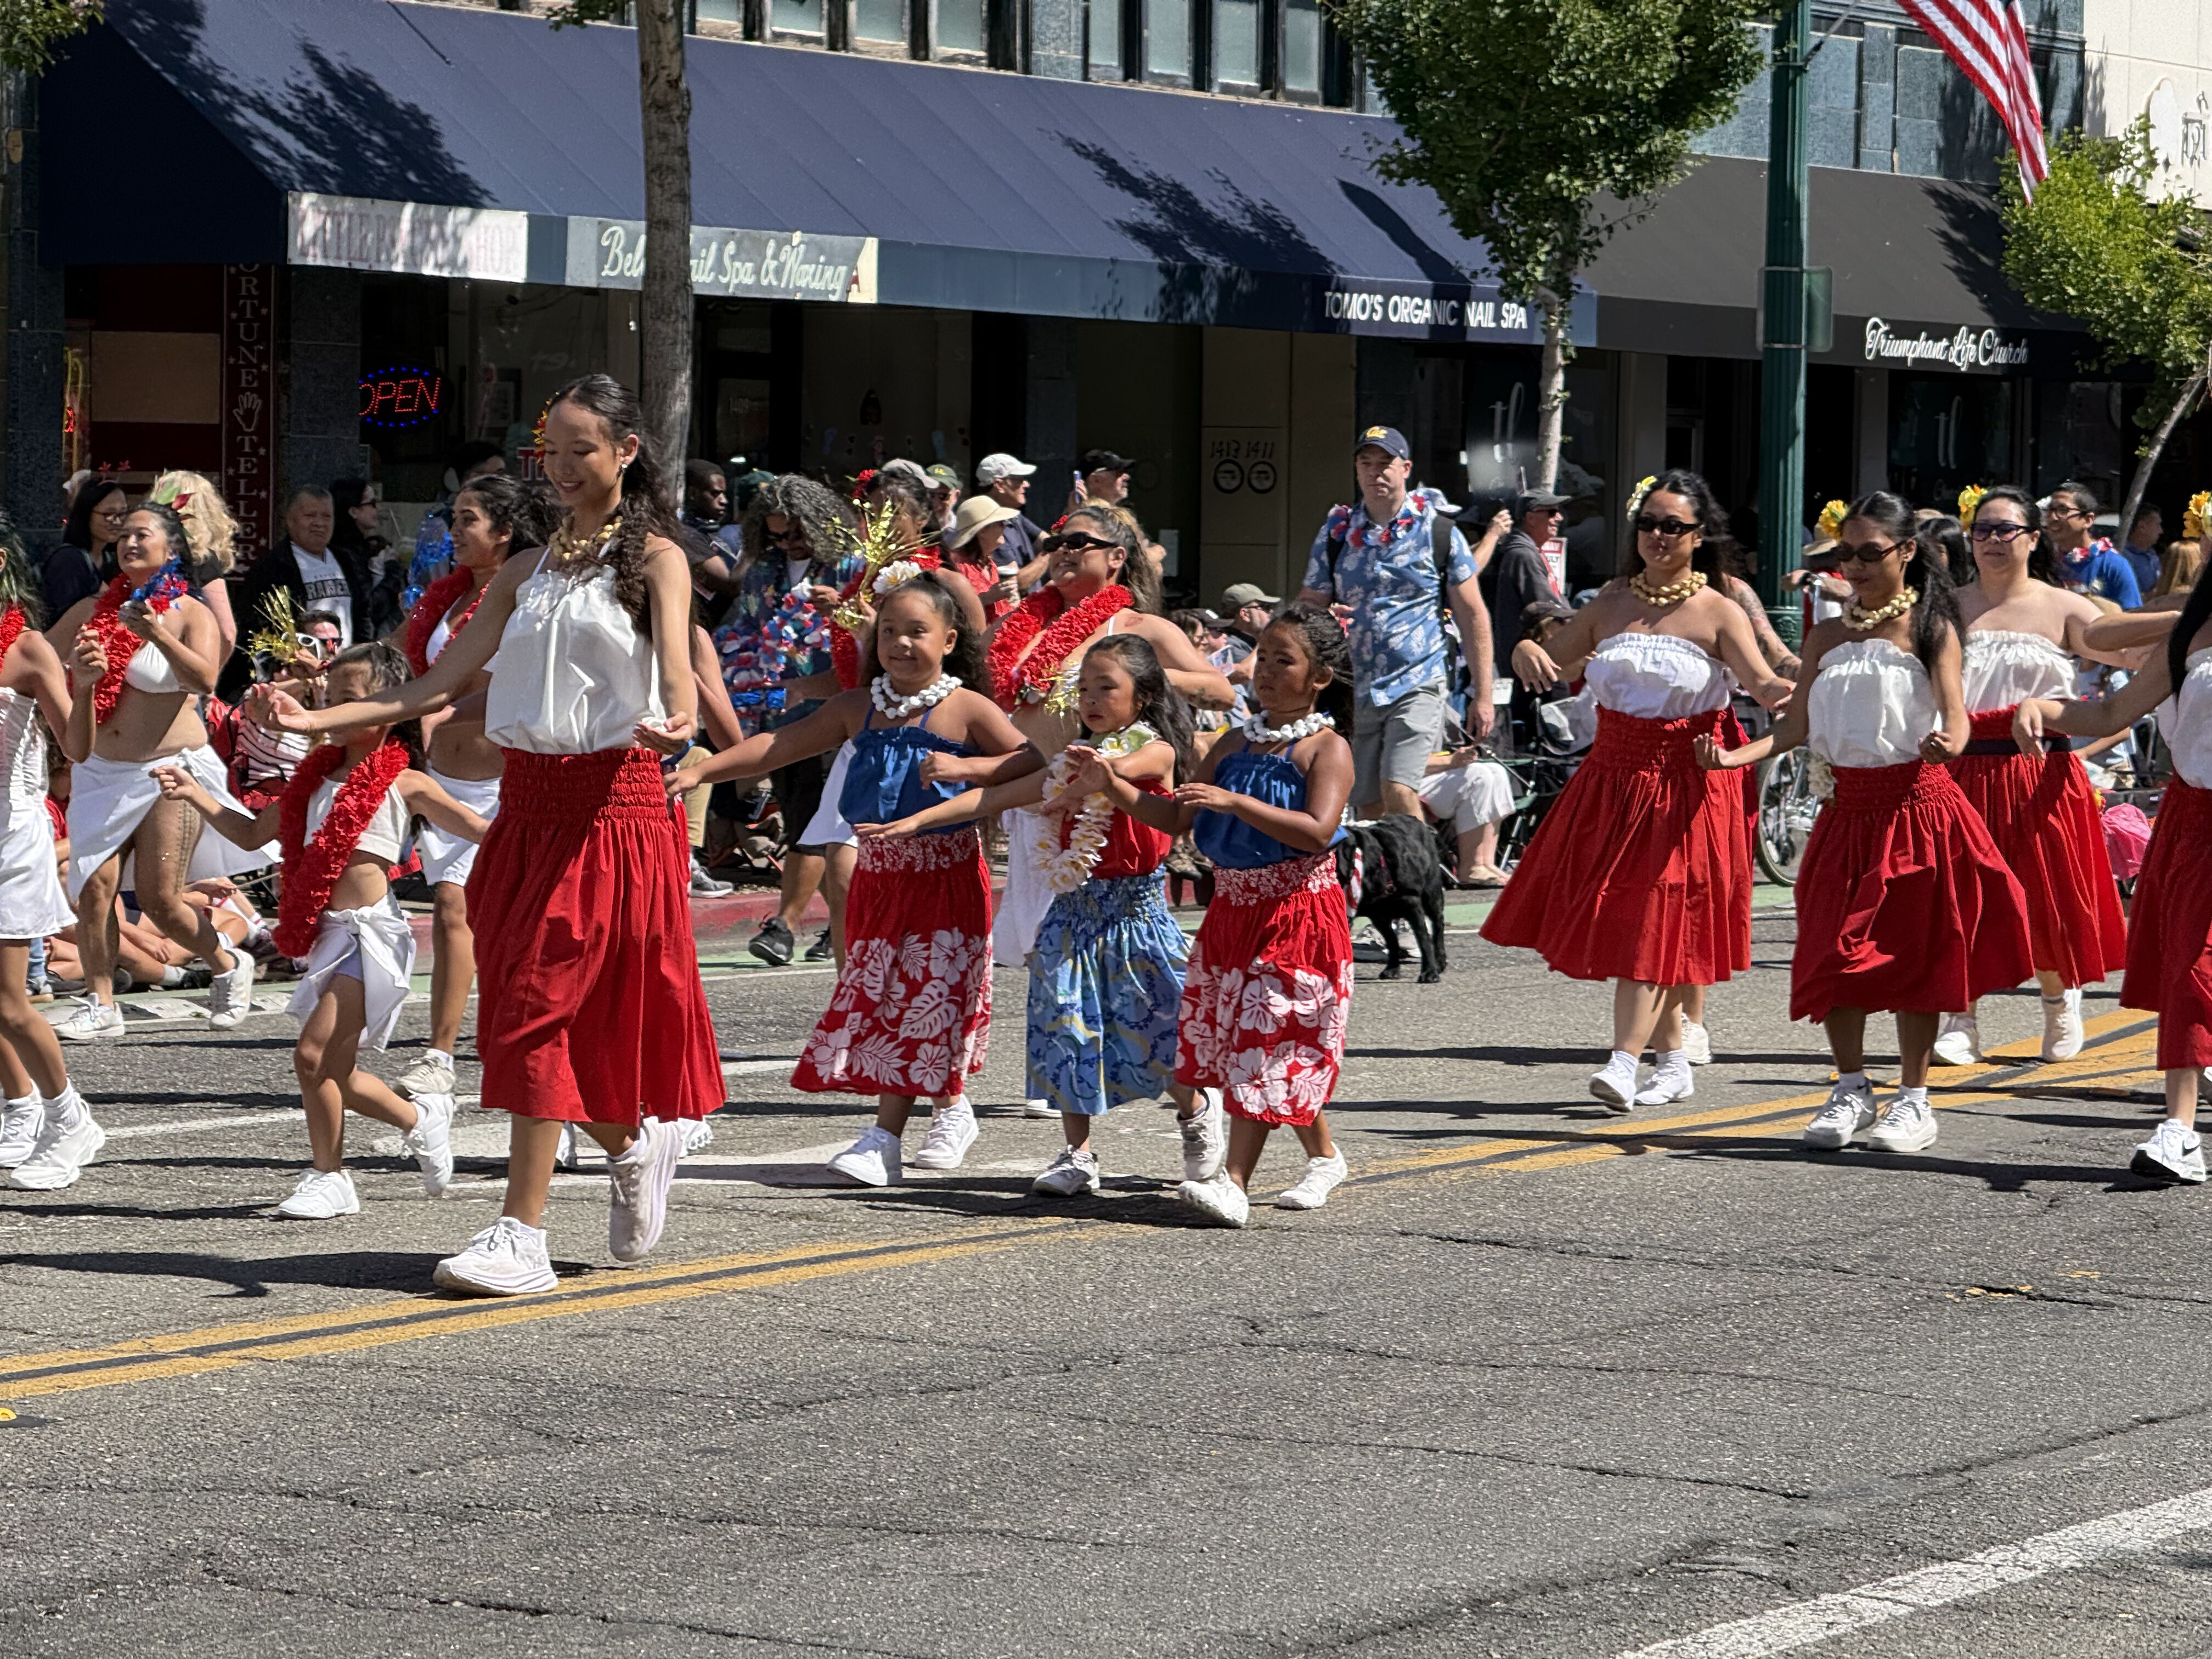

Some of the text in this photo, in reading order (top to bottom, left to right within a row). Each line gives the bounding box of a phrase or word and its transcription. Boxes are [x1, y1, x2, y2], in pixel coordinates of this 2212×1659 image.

[718, 240, 754, 293] Spa
[760, 239, 779, 286] &
[779, 244, 848, 301] Waxing
[1324, 291, 1528, 329] TOMO'S ORGANIC NAIL SPA
[1865, 316, 2029, 371] Triumphant Life Church
[235, 264, 261, 561] RTUNE TELLER
[358, 377, 441, 415] OPEN
[1246, 441, 1275, 460] 1411
